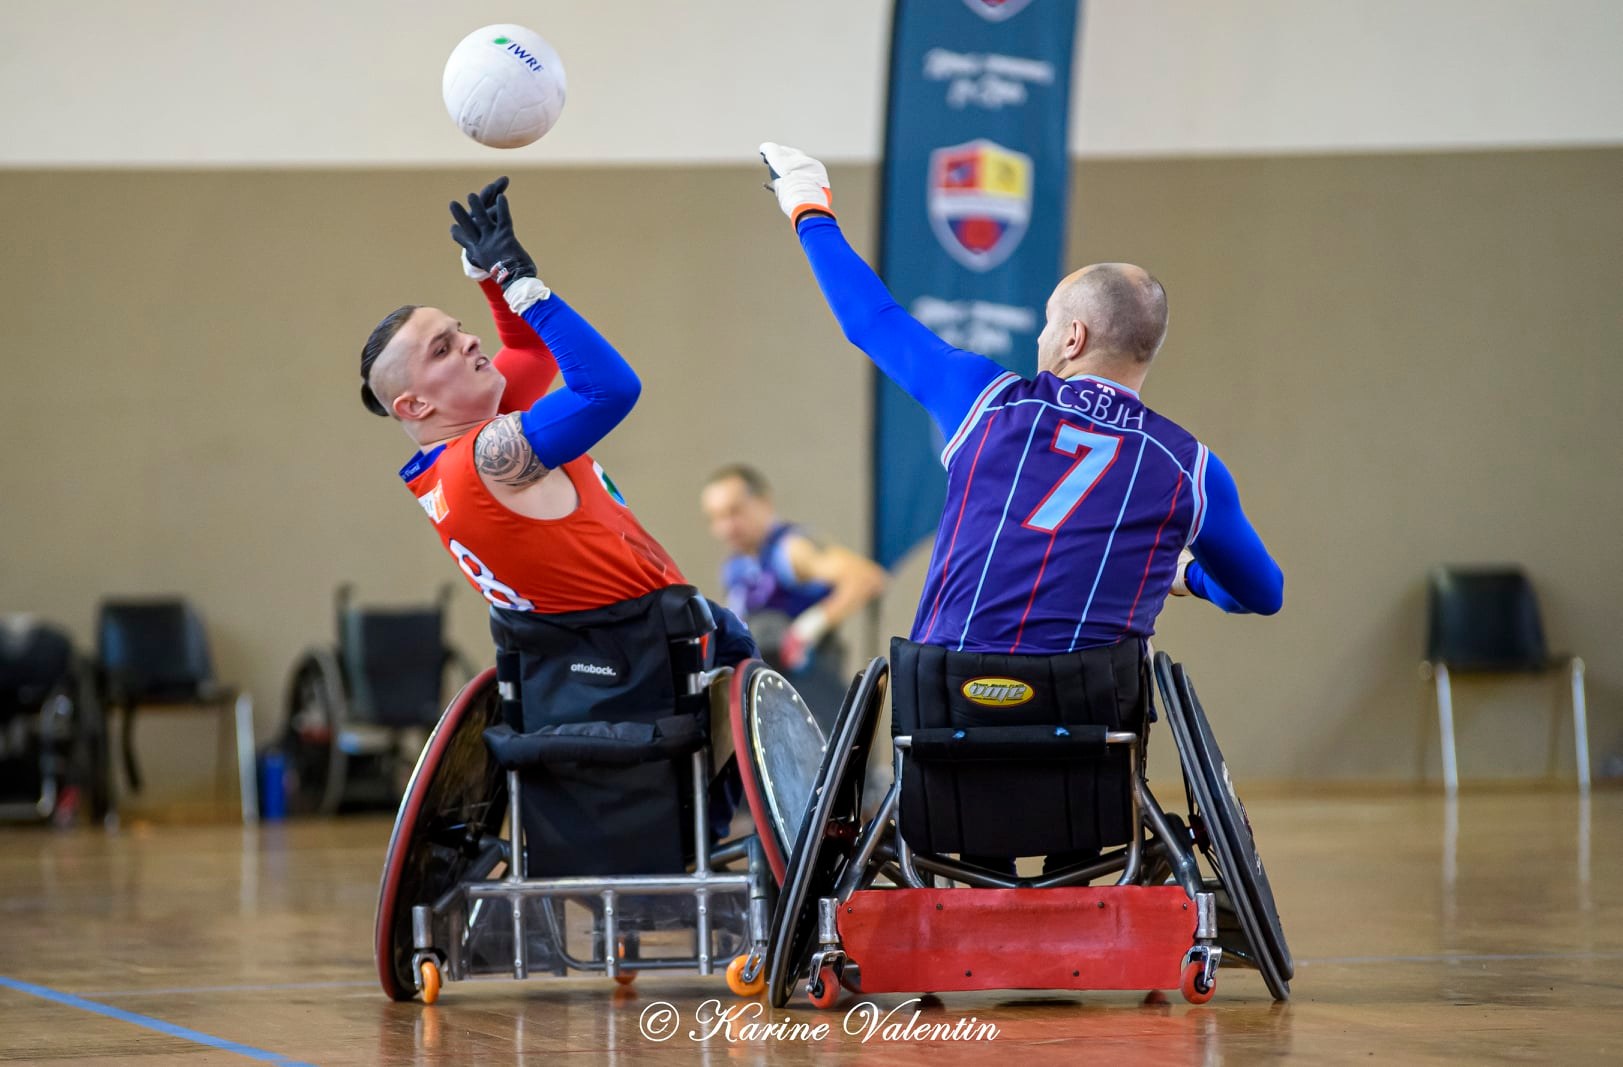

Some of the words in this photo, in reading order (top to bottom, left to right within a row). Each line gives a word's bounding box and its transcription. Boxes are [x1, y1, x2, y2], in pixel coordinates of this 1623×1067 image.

[507, 43, 544, 72] IWRF
[1056, 384, 1144, 430] CSBJH
[1021, 418, 1124, 534] 7
